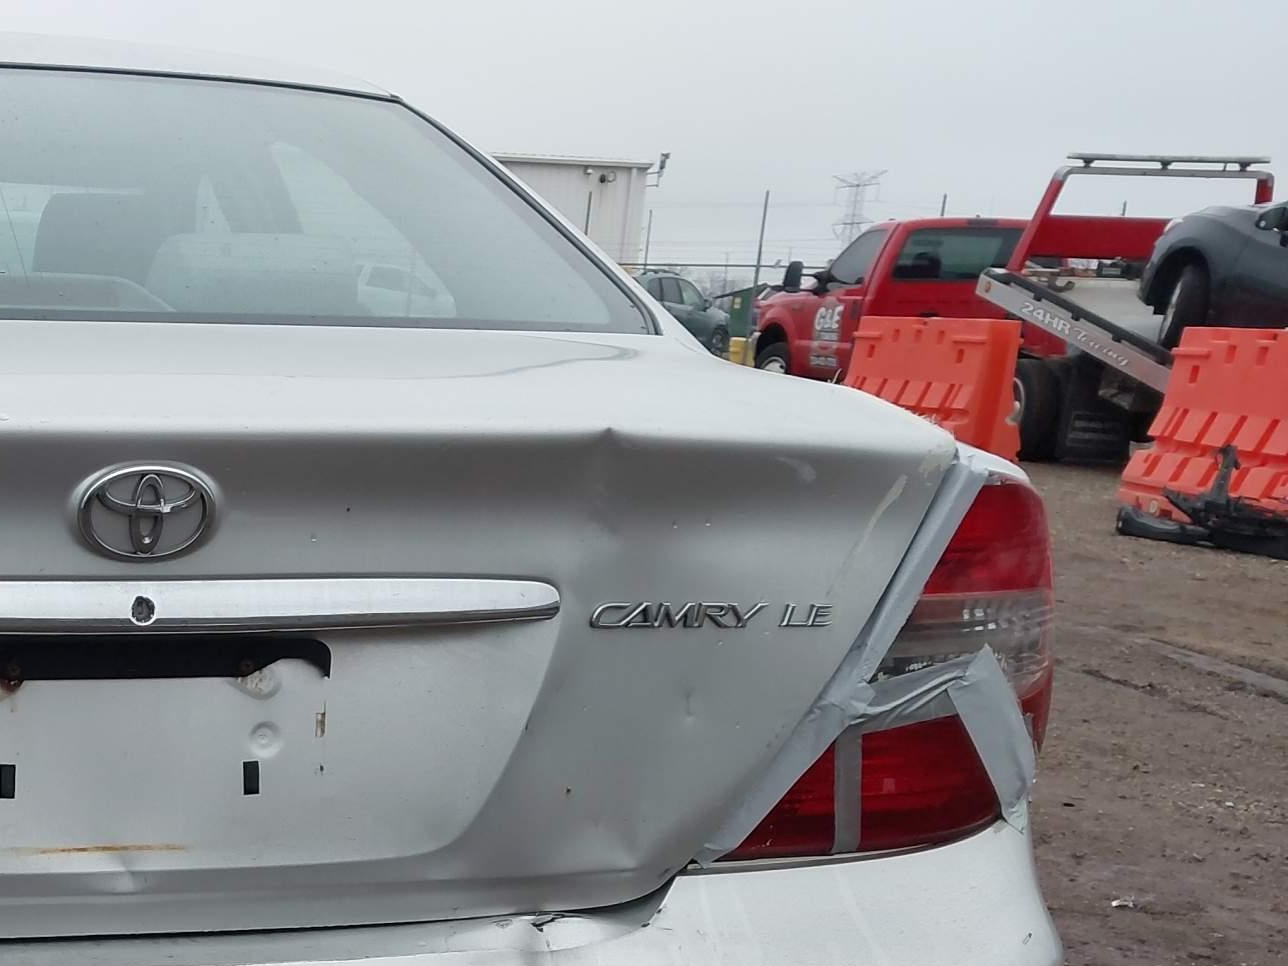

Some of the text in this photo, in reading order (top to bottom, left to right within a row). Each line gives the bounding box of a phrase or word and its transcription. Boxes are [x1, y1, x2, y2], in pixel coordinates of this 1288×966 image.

[1020, 302, 1072, 335] 24HR
[590, 602, 833, 629] CAMRY LE
